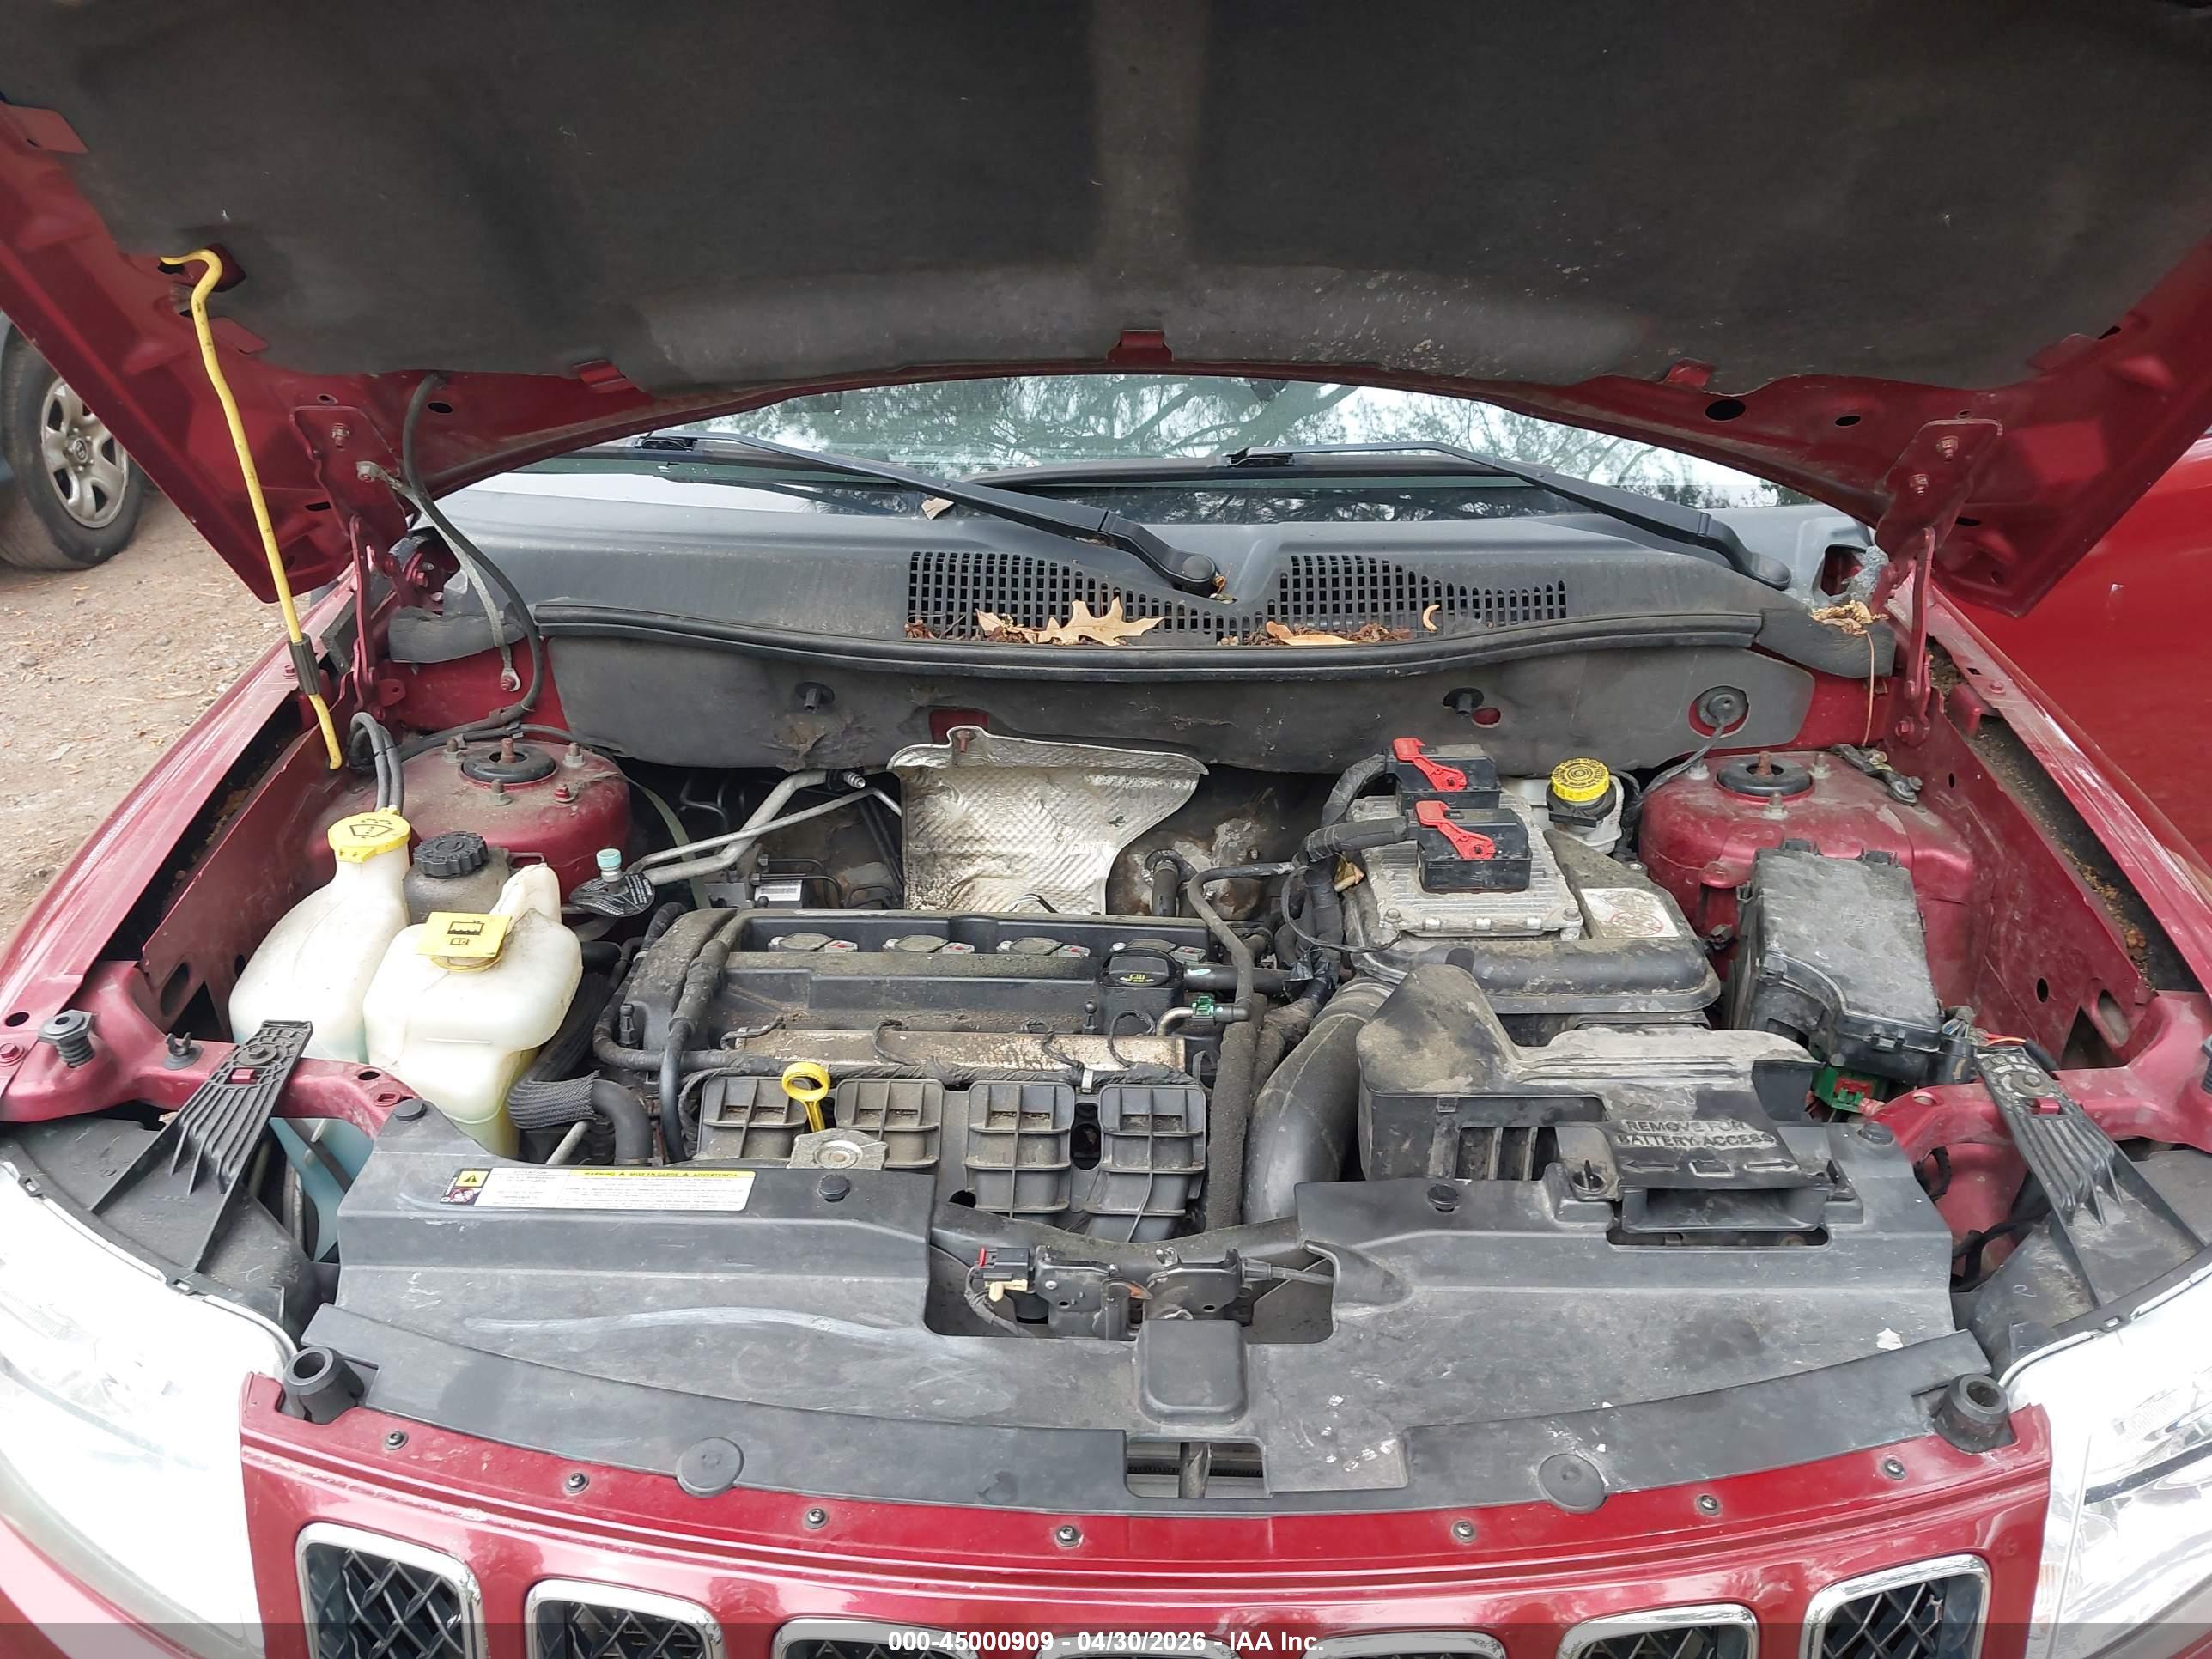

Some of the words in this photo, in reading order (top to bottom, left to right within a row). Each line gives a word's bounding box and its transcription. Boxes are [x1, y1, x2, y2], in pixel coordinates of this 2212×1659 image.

[1626, 1120, 1705, 1133] REMOVE
[1708, 1119, 1745, 1132] FOR
[1617, 1133, 1695, 1147] BATTERY
[1703, 1133, 1777, 1147] ACCESS
